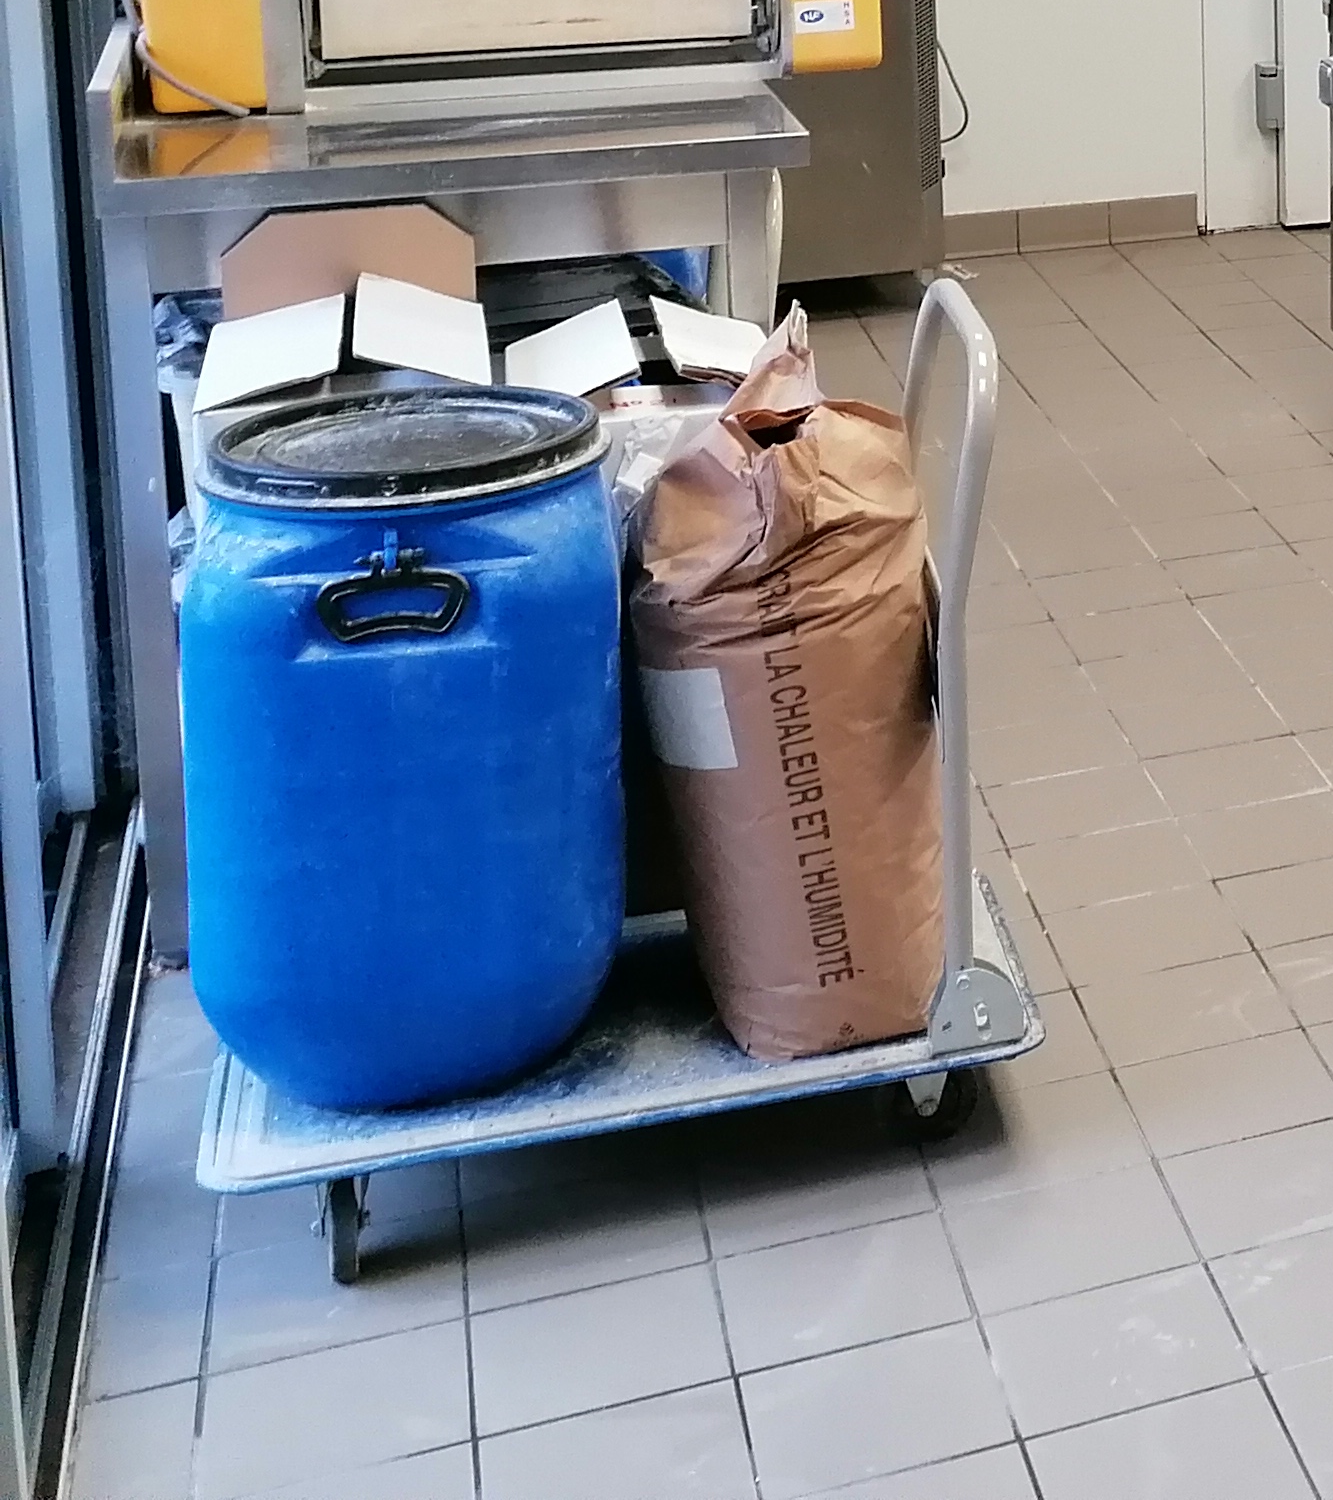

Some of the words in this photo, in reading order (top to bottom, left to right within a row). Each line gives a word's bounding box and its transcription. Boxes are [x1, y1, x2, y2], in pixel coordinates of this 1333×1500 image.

[764, 645, 802, 683] LA
[770, 685, 824, 808] CHALEUR
[791, 809, 831, 843] ET
[798, 847, 864, 988] L'HUMIDITÉ
